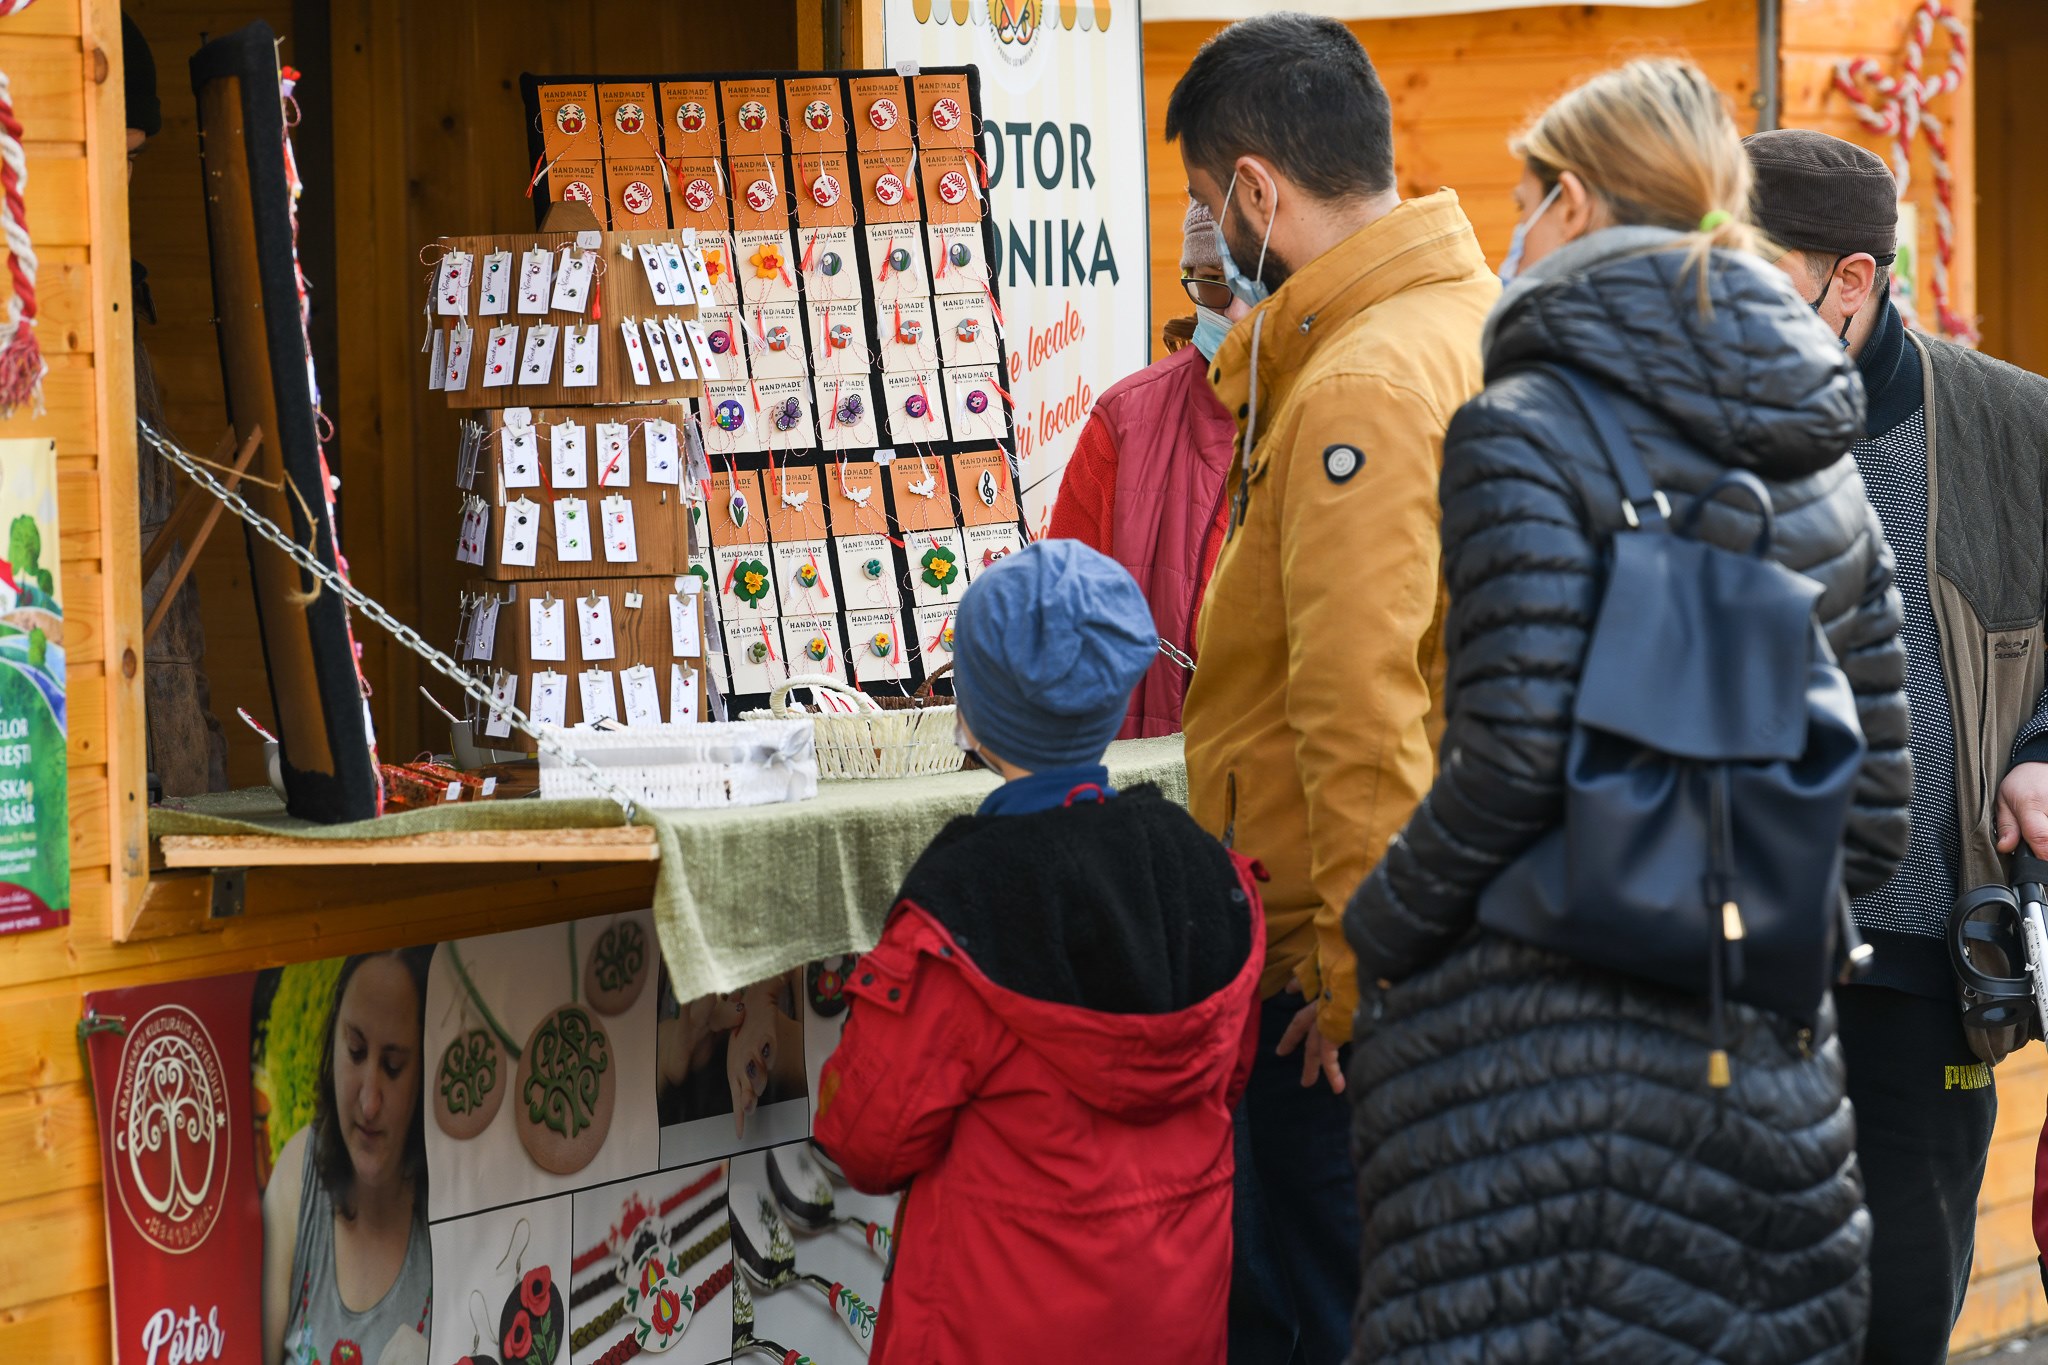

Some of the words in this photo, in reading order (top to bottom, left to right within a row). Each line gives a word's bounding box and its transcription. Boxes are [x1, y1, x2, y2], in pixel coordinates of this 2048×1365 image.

[790, 84, 832, 93] HANDMADE
[856, 84, 898, 92] HANDMADE
[544, 90, 587, 99] HANDMADE
[603, 91, 646, 99] HANDMADE
[863, 156, 906, 165] HANDMADE
[552, 166, 595, 174] HANDMADE
[871, 228, 913, 237] HANDMADE
[933, 226, 975, 234] HANDMADE
[741, 234, 784, 243] HANDMADE
[805, 231, 847, 241] HANDMADE
[698, 237, 725, 245] DMADE
[882, 302, 924, 311] HANDMADE
[942, 297, 985, 307] HANDMADE
[815, 304, 857, 313] HANDMADE
[1028, 300, 1086, 372] locale,
[952, 371, 994, 380] HANDMADE
[759, 381, 801, 392] HANDMADE
[1040, 375, 1093, 446] locale
[960, 456, 1002, 466] HANDMADE
[711, 478, 751, 487] ANDADE
[970, 528, 1012, 538] HANDMADE
[842, 539, 885, 549] HANDMADE
[916, 536, 953, 544] ANDMADE
[721, 550, 764, 558] HANDMADE
[780, 547, 822, 555] HANDMADE
[851, 613, 895, 623] HANDMADE
[921, 609, 957, 620] HANDMAD
[790, 620, 832, 629] HANDMADE
[730, 625, 773, 635] HANDMADE
[1944, 1062, 1991, 1090] PUMA
[142, 1304, 225, 1365] Pótor
